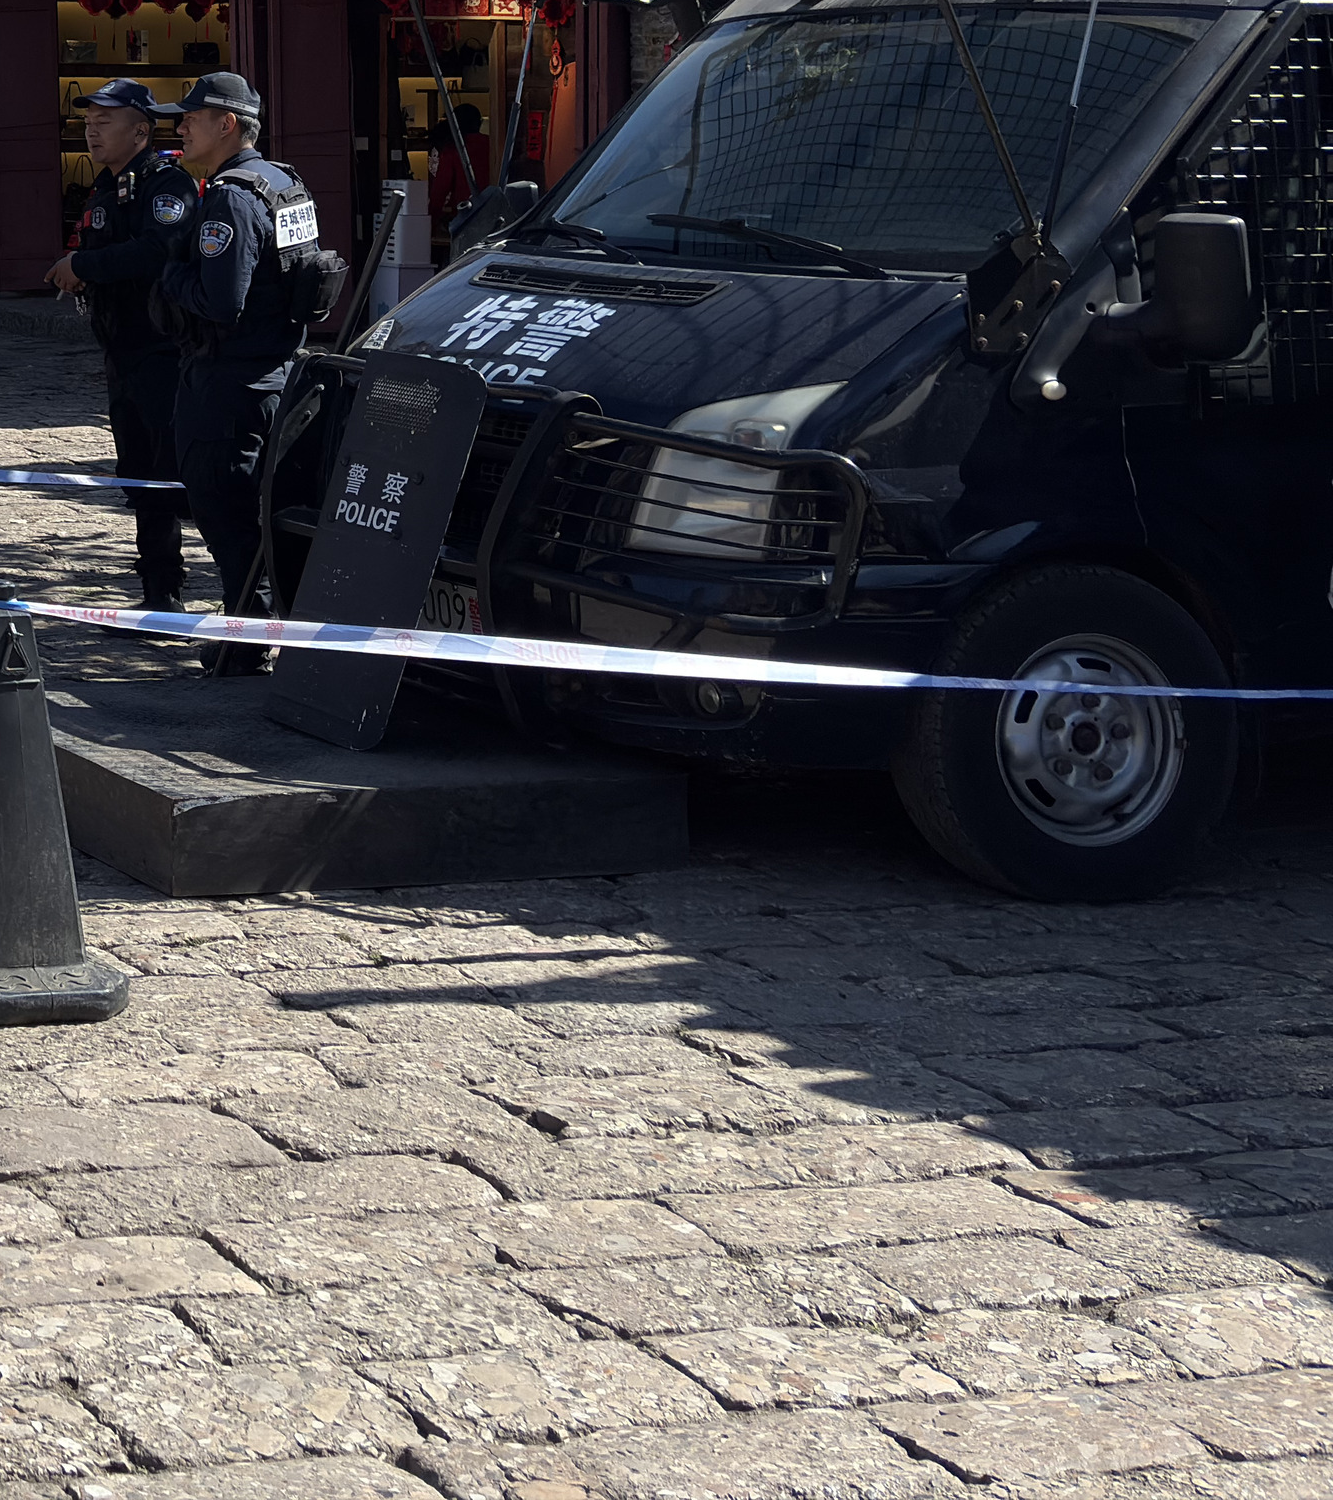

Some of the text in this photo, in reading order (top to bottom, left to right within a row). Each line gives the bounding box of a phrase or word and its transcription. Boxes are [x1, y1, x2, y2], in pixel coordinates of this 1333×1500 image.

[438, 292, 618, 364] 特警
[344, 462, 410, 505] 警察
[334, 499, 402, 534] POLICE
